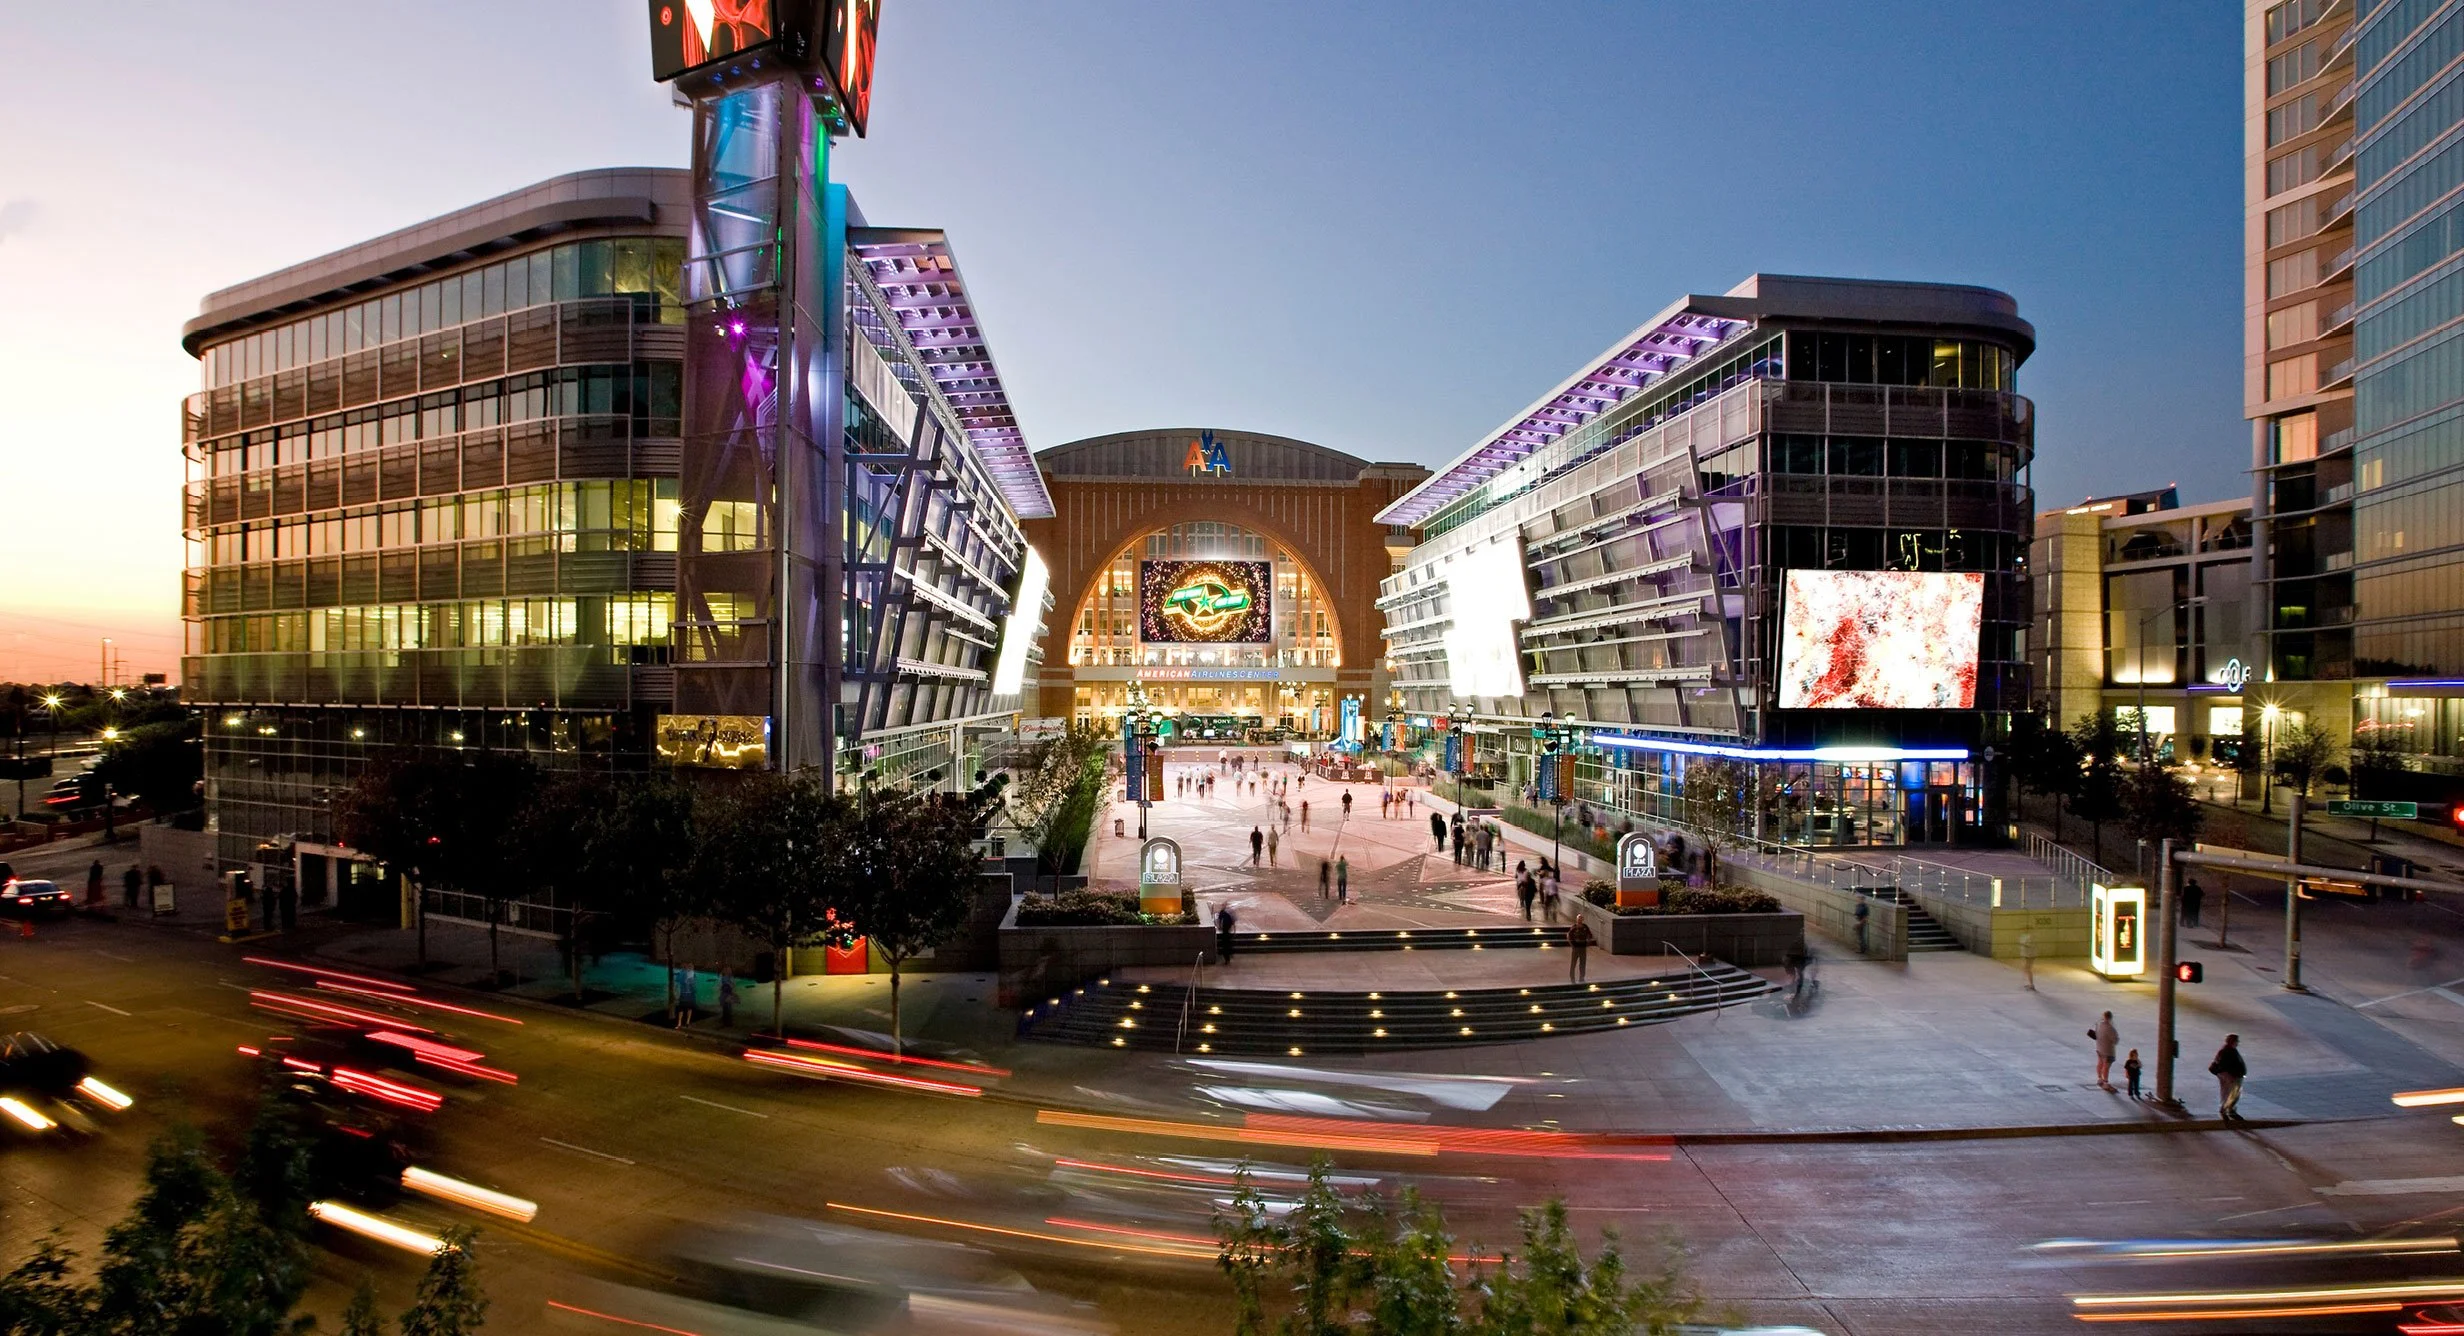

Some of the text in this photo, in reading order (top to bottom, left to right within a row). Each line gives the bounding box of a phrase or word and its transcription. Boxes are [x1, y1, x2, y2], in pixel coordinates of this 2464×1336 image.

[1136, 669, 1191, 678] AMERICAN
[1546, 756, 1554, 798] Welcome
[2343, 802, 2400, 811] Olive St.
[1626, 868, 1653, 877] PLAZA
